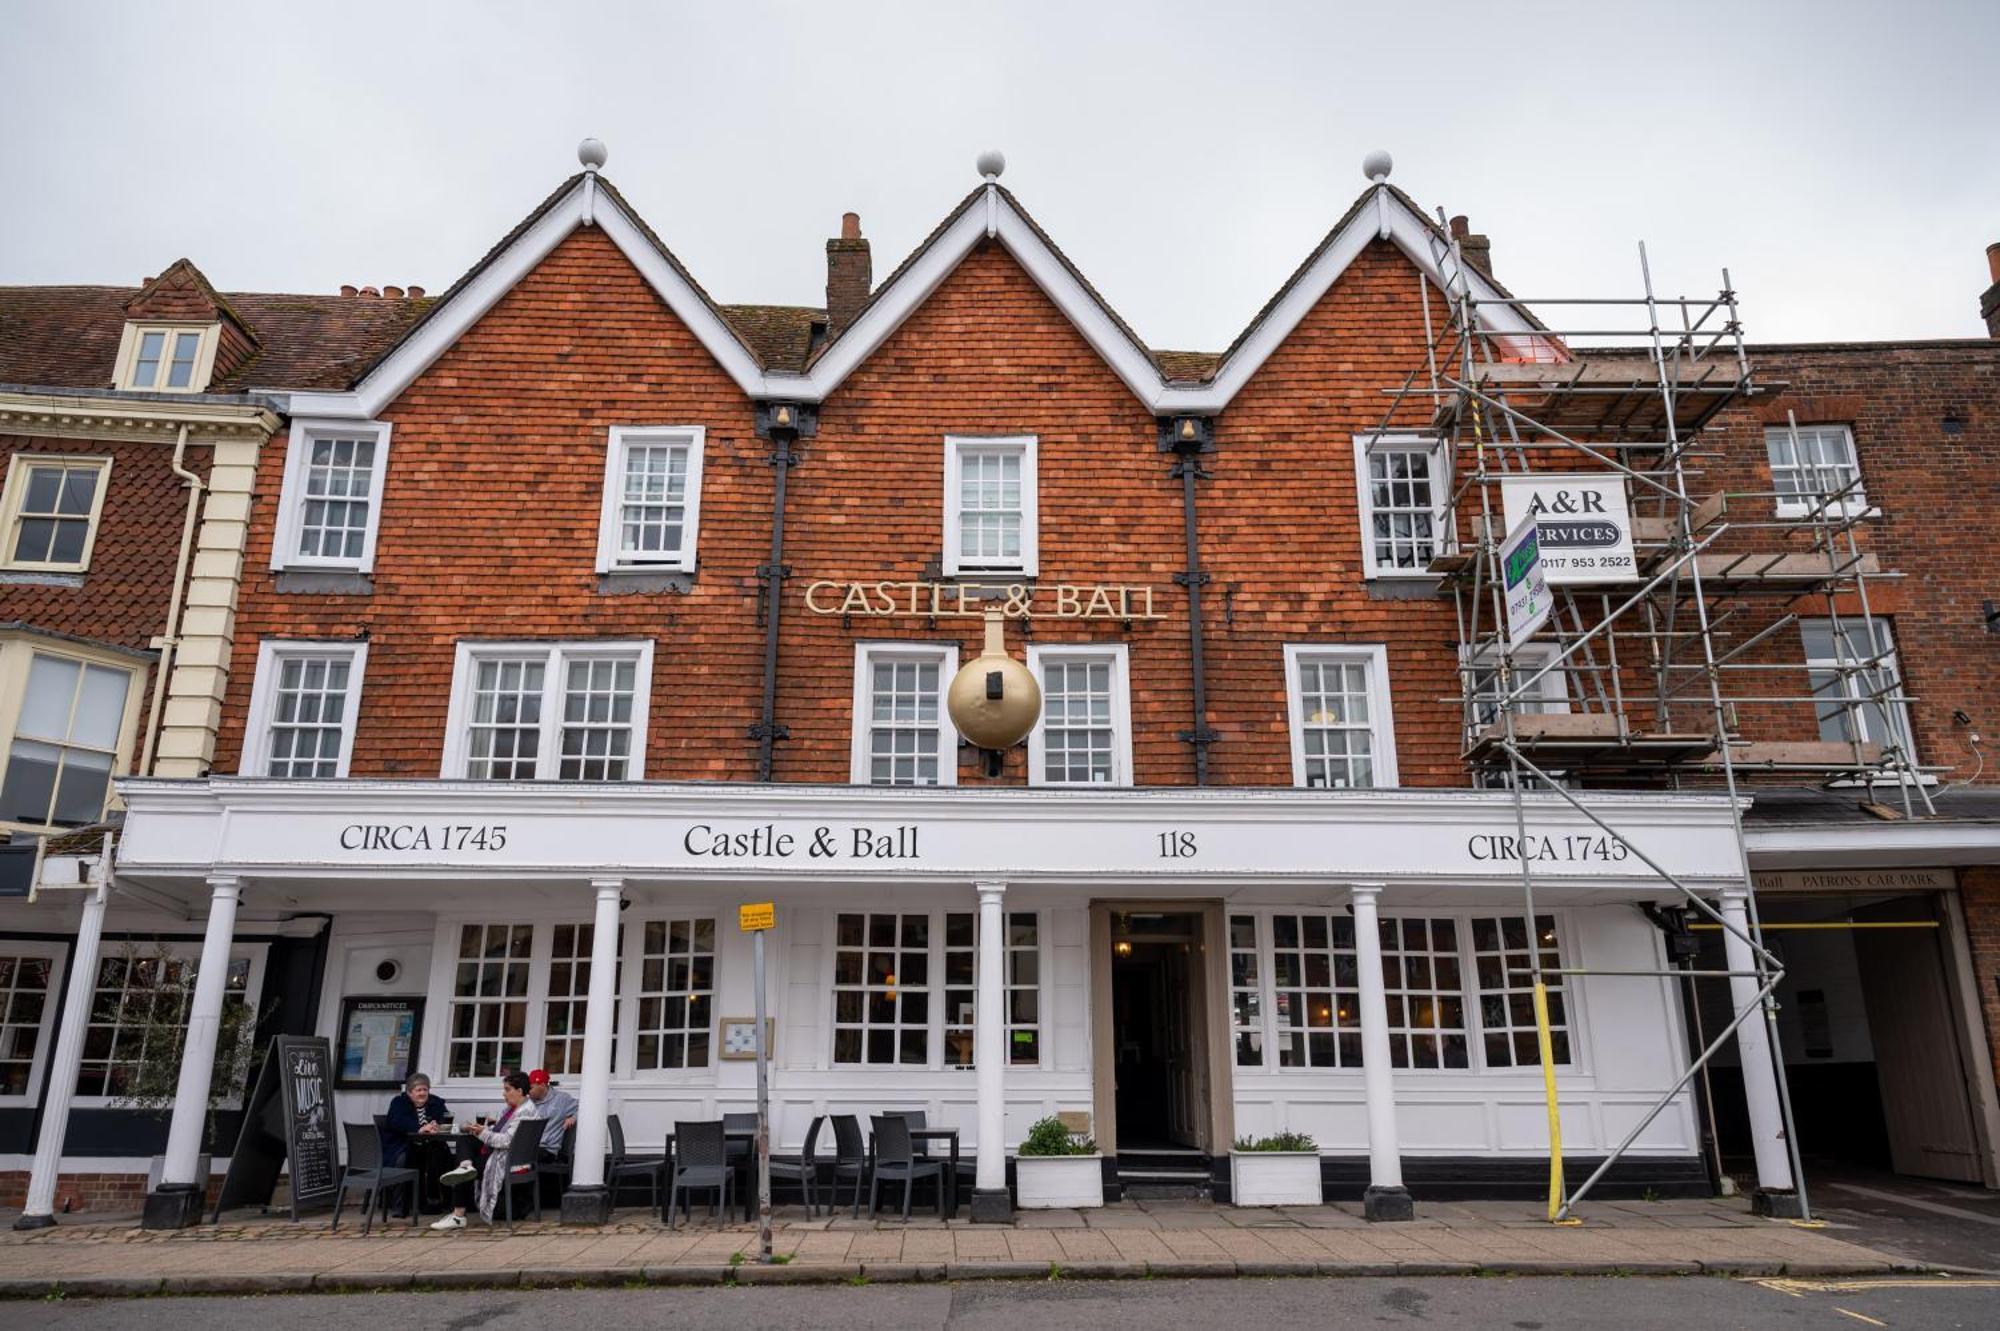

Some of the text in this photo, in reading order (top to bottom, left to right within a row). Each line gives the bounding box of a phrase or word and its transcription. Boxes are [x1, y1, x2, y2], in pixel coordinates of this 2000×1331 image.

[1526, 490, 1607, 514] A&R
[1537, 527, 1616, 542] ERVICES
[1541, 557, 1632, 568] 0117 953 2522
[805, 581, 1165, 618] CASTLE & BALL
[340, 825, 507, 851] CIRCA 1745
[684, 824, 921, 858] Castle & Ball
[1157, 830, 1197, 858] 118
[1468, 835, 1628, 861] CIRCA 1745
[1758, 873, 1937, 889] Ball PATRONS CAR PARK
[295, 1077, 324, 1115] MUSIC
